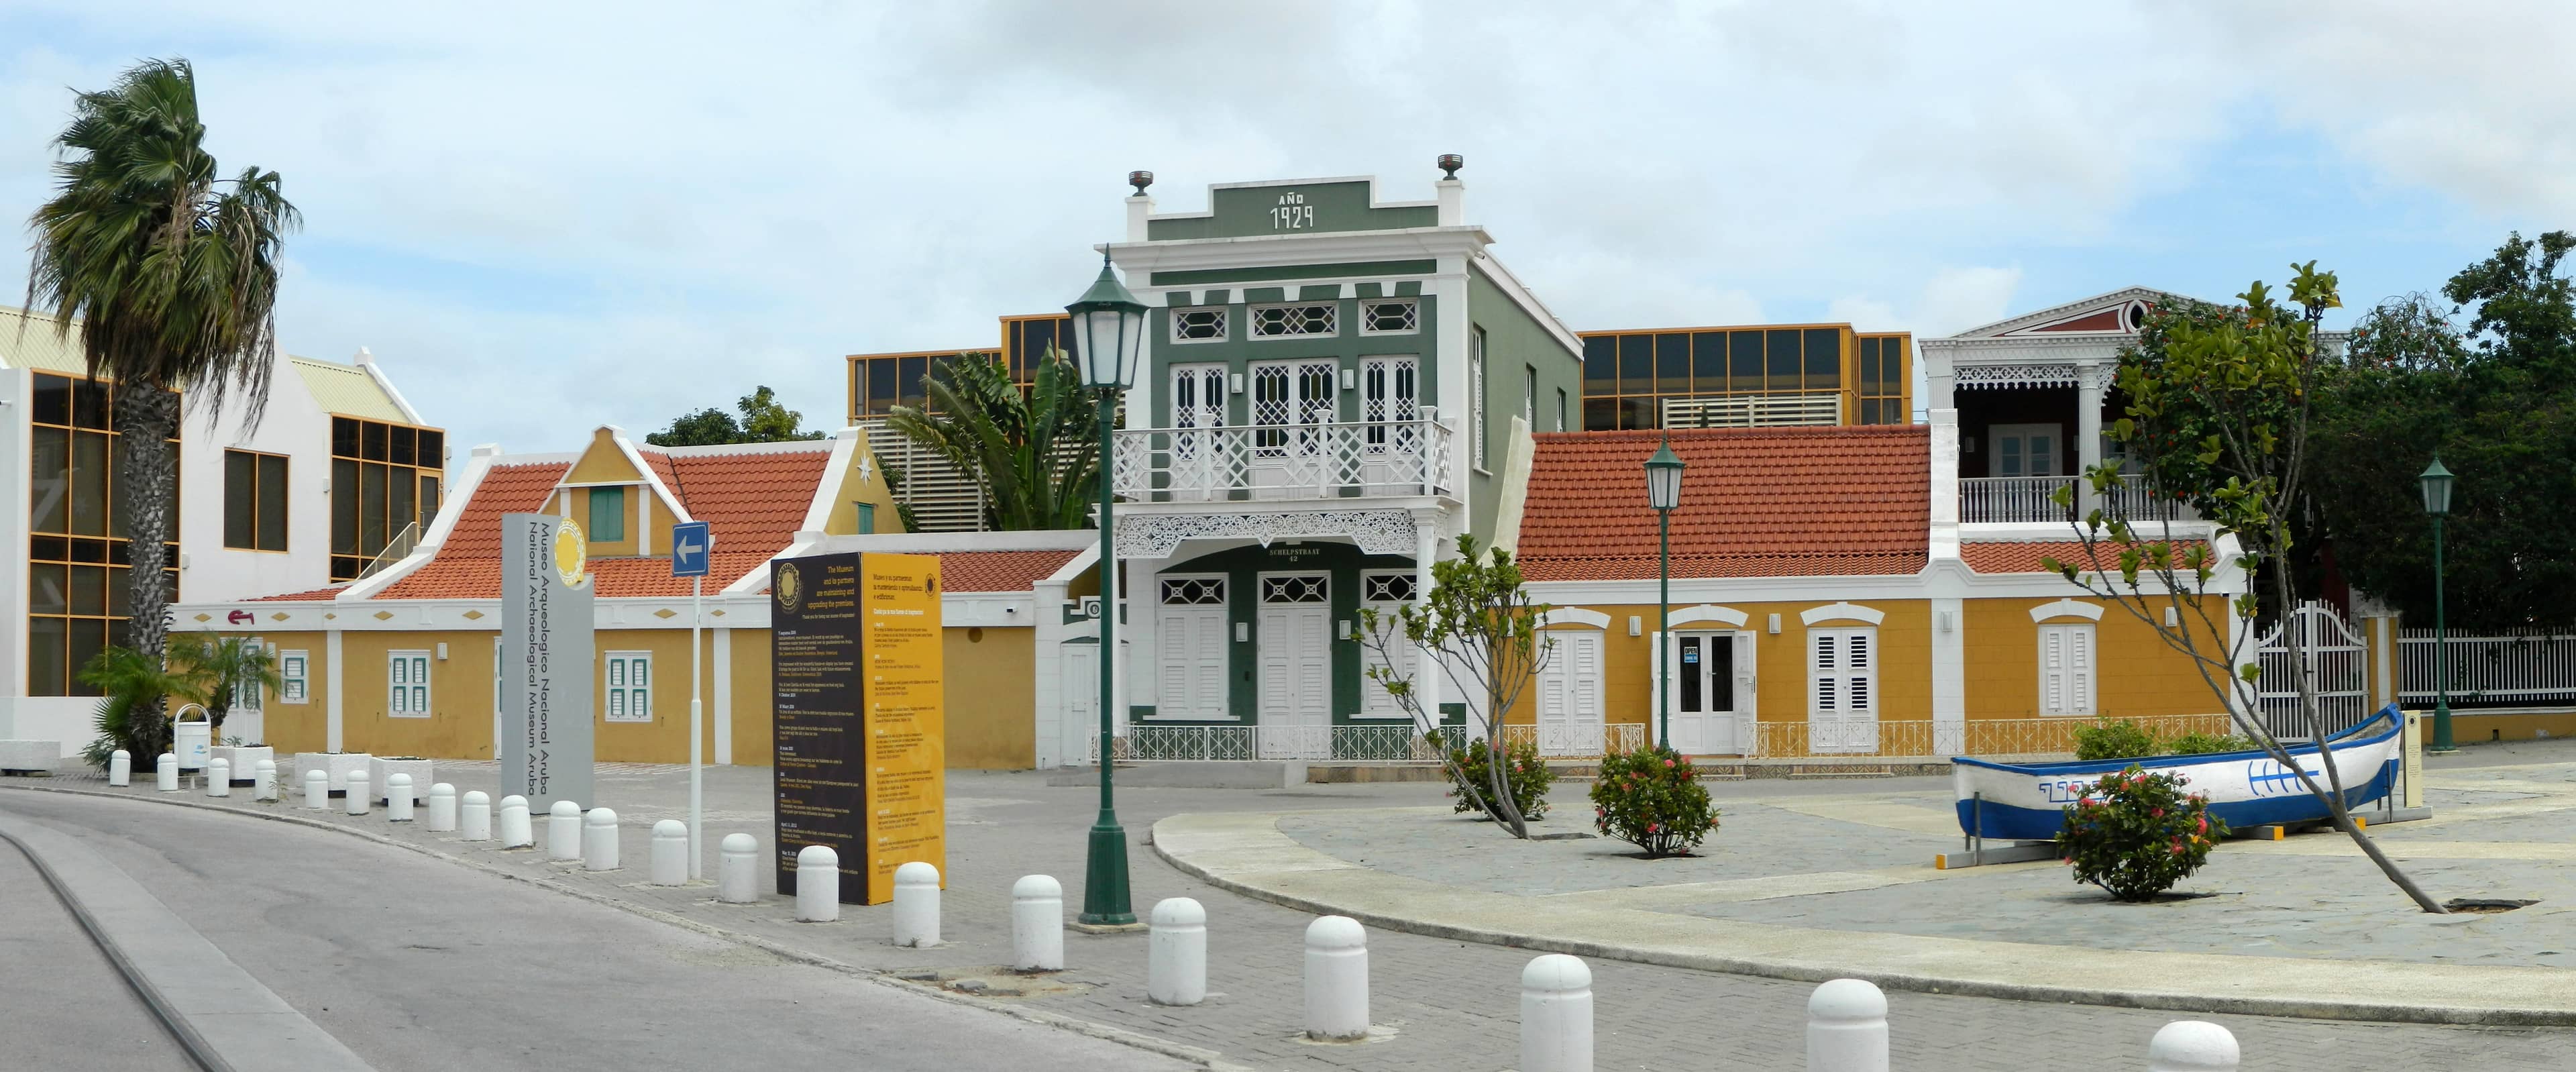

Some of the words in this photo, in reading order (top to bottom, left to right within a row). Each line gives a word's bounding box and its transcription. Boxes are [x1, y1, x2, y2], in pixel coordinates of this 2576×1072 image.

[1270, 205, 1313, 229] 1929
[1279, 192, 1303, 205] AÑO
[529, 522, 538, 580] National
[541, 523, 550, 570] Museo
[527, 584, 538, 686] Archaeological
[539, 576, 551, 673] Arqueologico
[529, 692, 537, 748] Museum
[541, 678, 550, 744] Nacional
[528, 753, 537, 796] Aruba
[540, 749, 550, 795] Aruba
